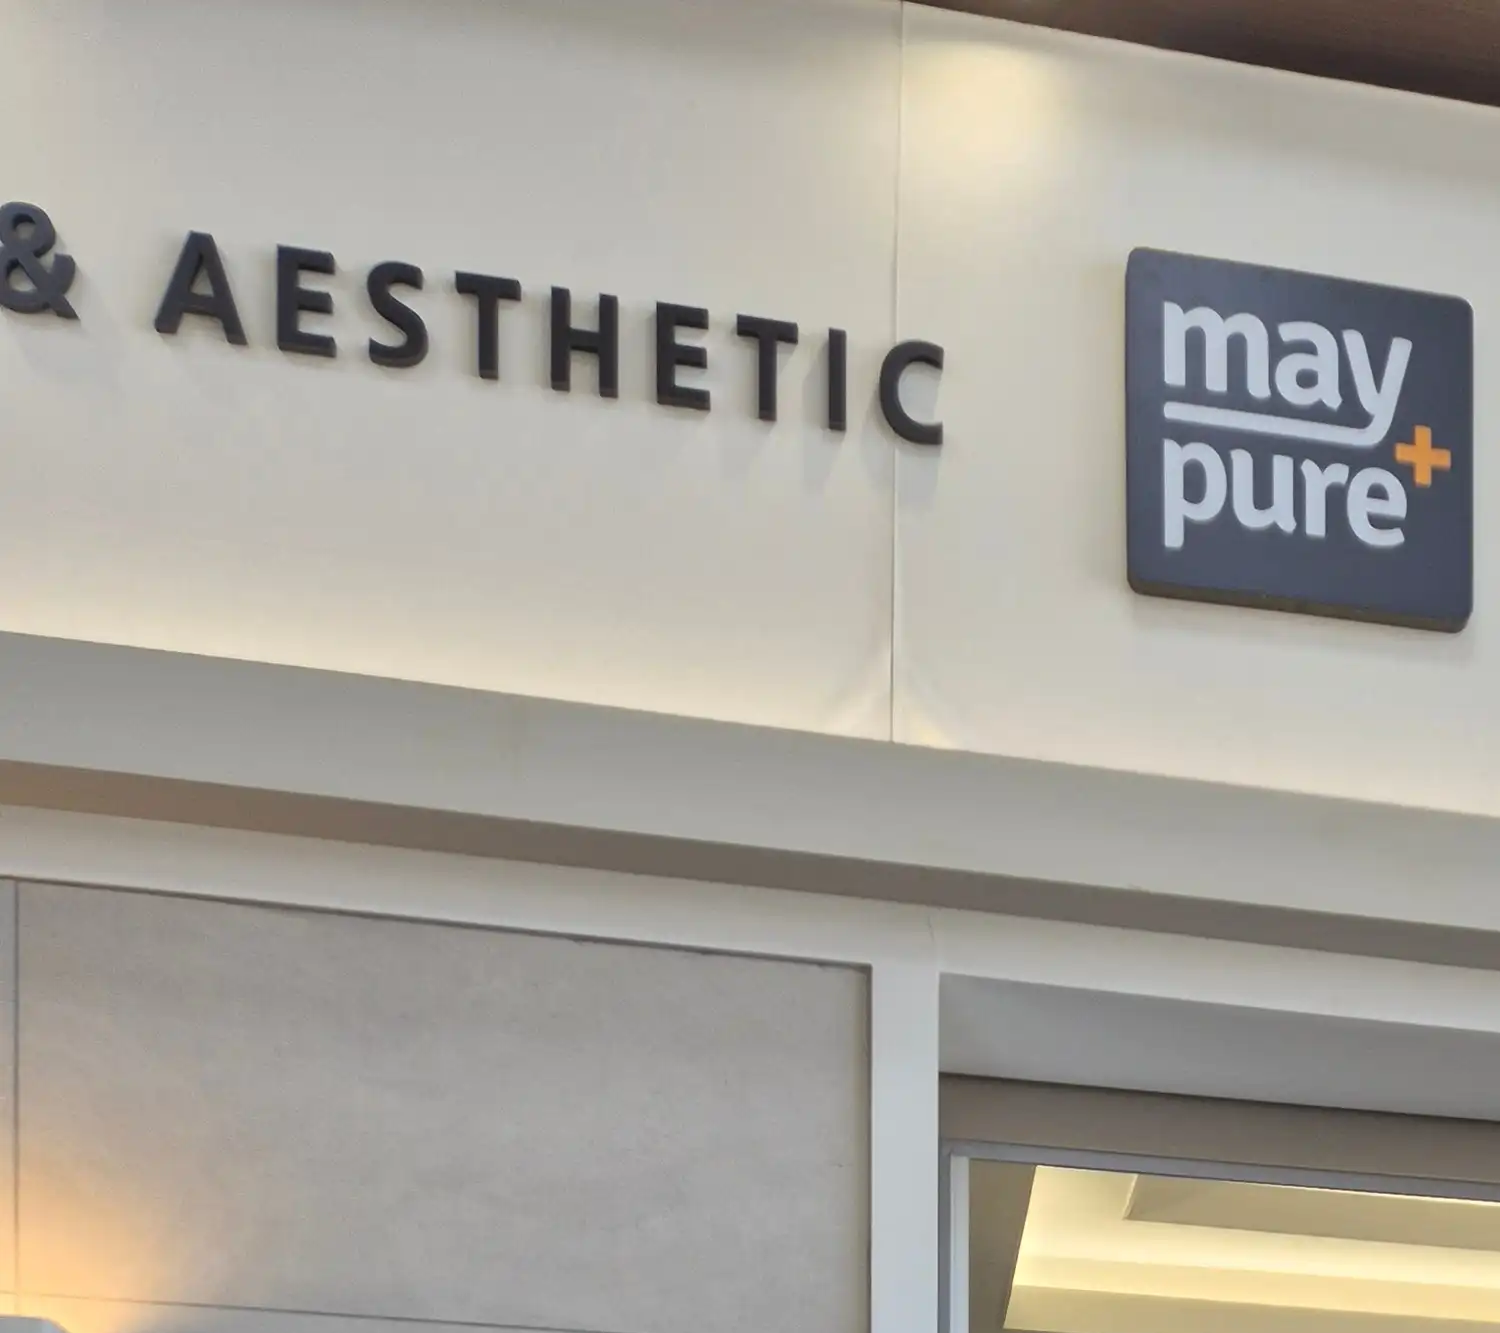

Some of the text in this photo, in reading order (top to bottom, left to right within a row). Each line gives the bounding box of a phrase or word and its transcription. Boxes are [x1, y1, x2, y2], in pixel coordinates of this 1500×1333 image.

[0, 201, 945, 446] & AESTHETIC
[1164, 301, 1413, 449] may
